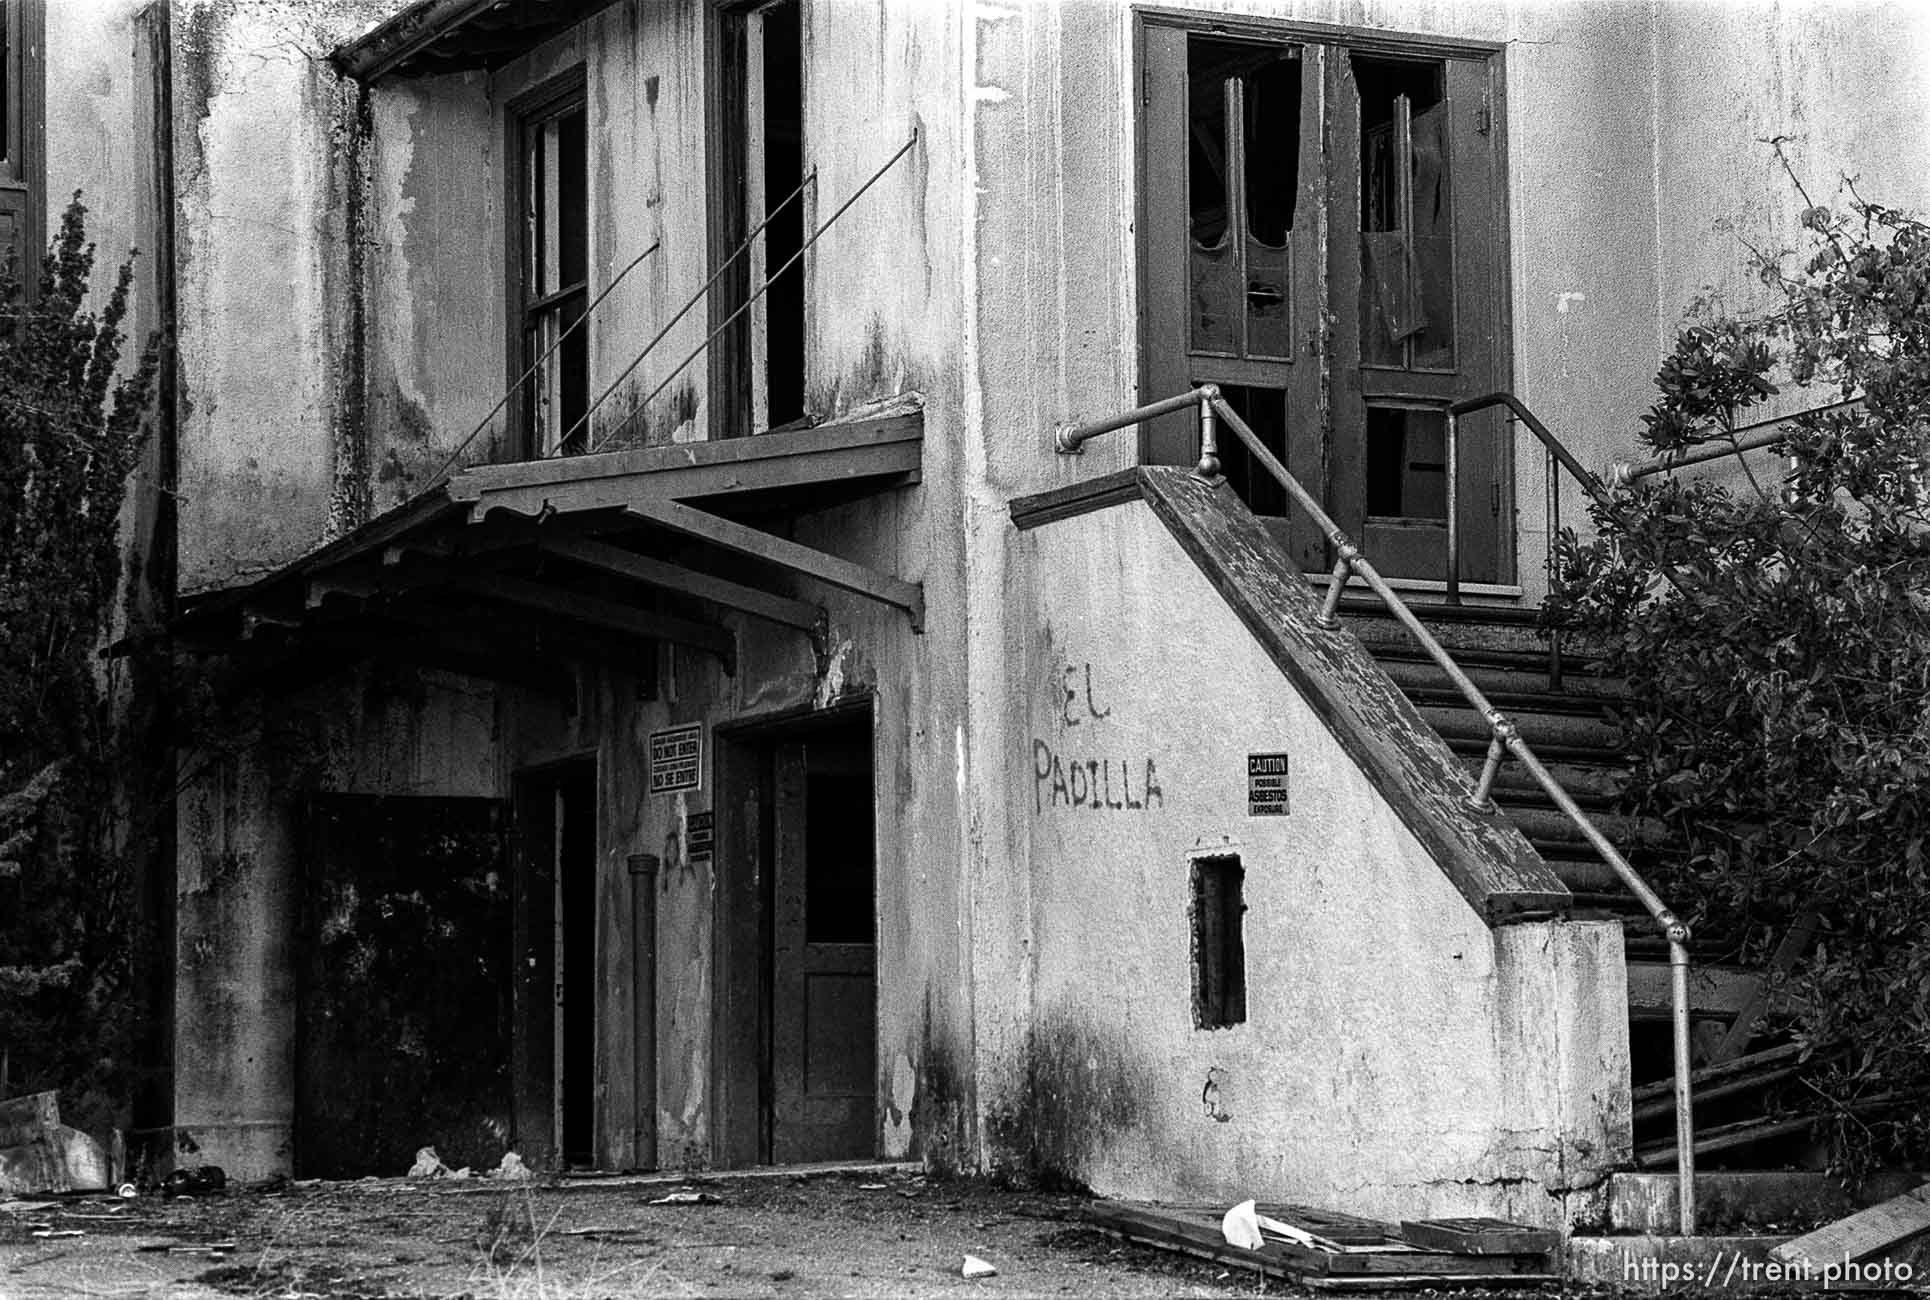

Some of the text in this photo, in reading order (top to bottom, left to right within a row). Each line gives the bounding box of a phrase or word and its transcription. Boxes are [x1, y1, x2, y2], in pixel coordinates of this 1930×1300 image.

[1062, 663, 1111, 727] EL
[1033, 738, 1164, 816] PADILLA
[1249, 758, 1286, 773] CAUTION
[1248, 789, 1287, 803] ASBESTOS
